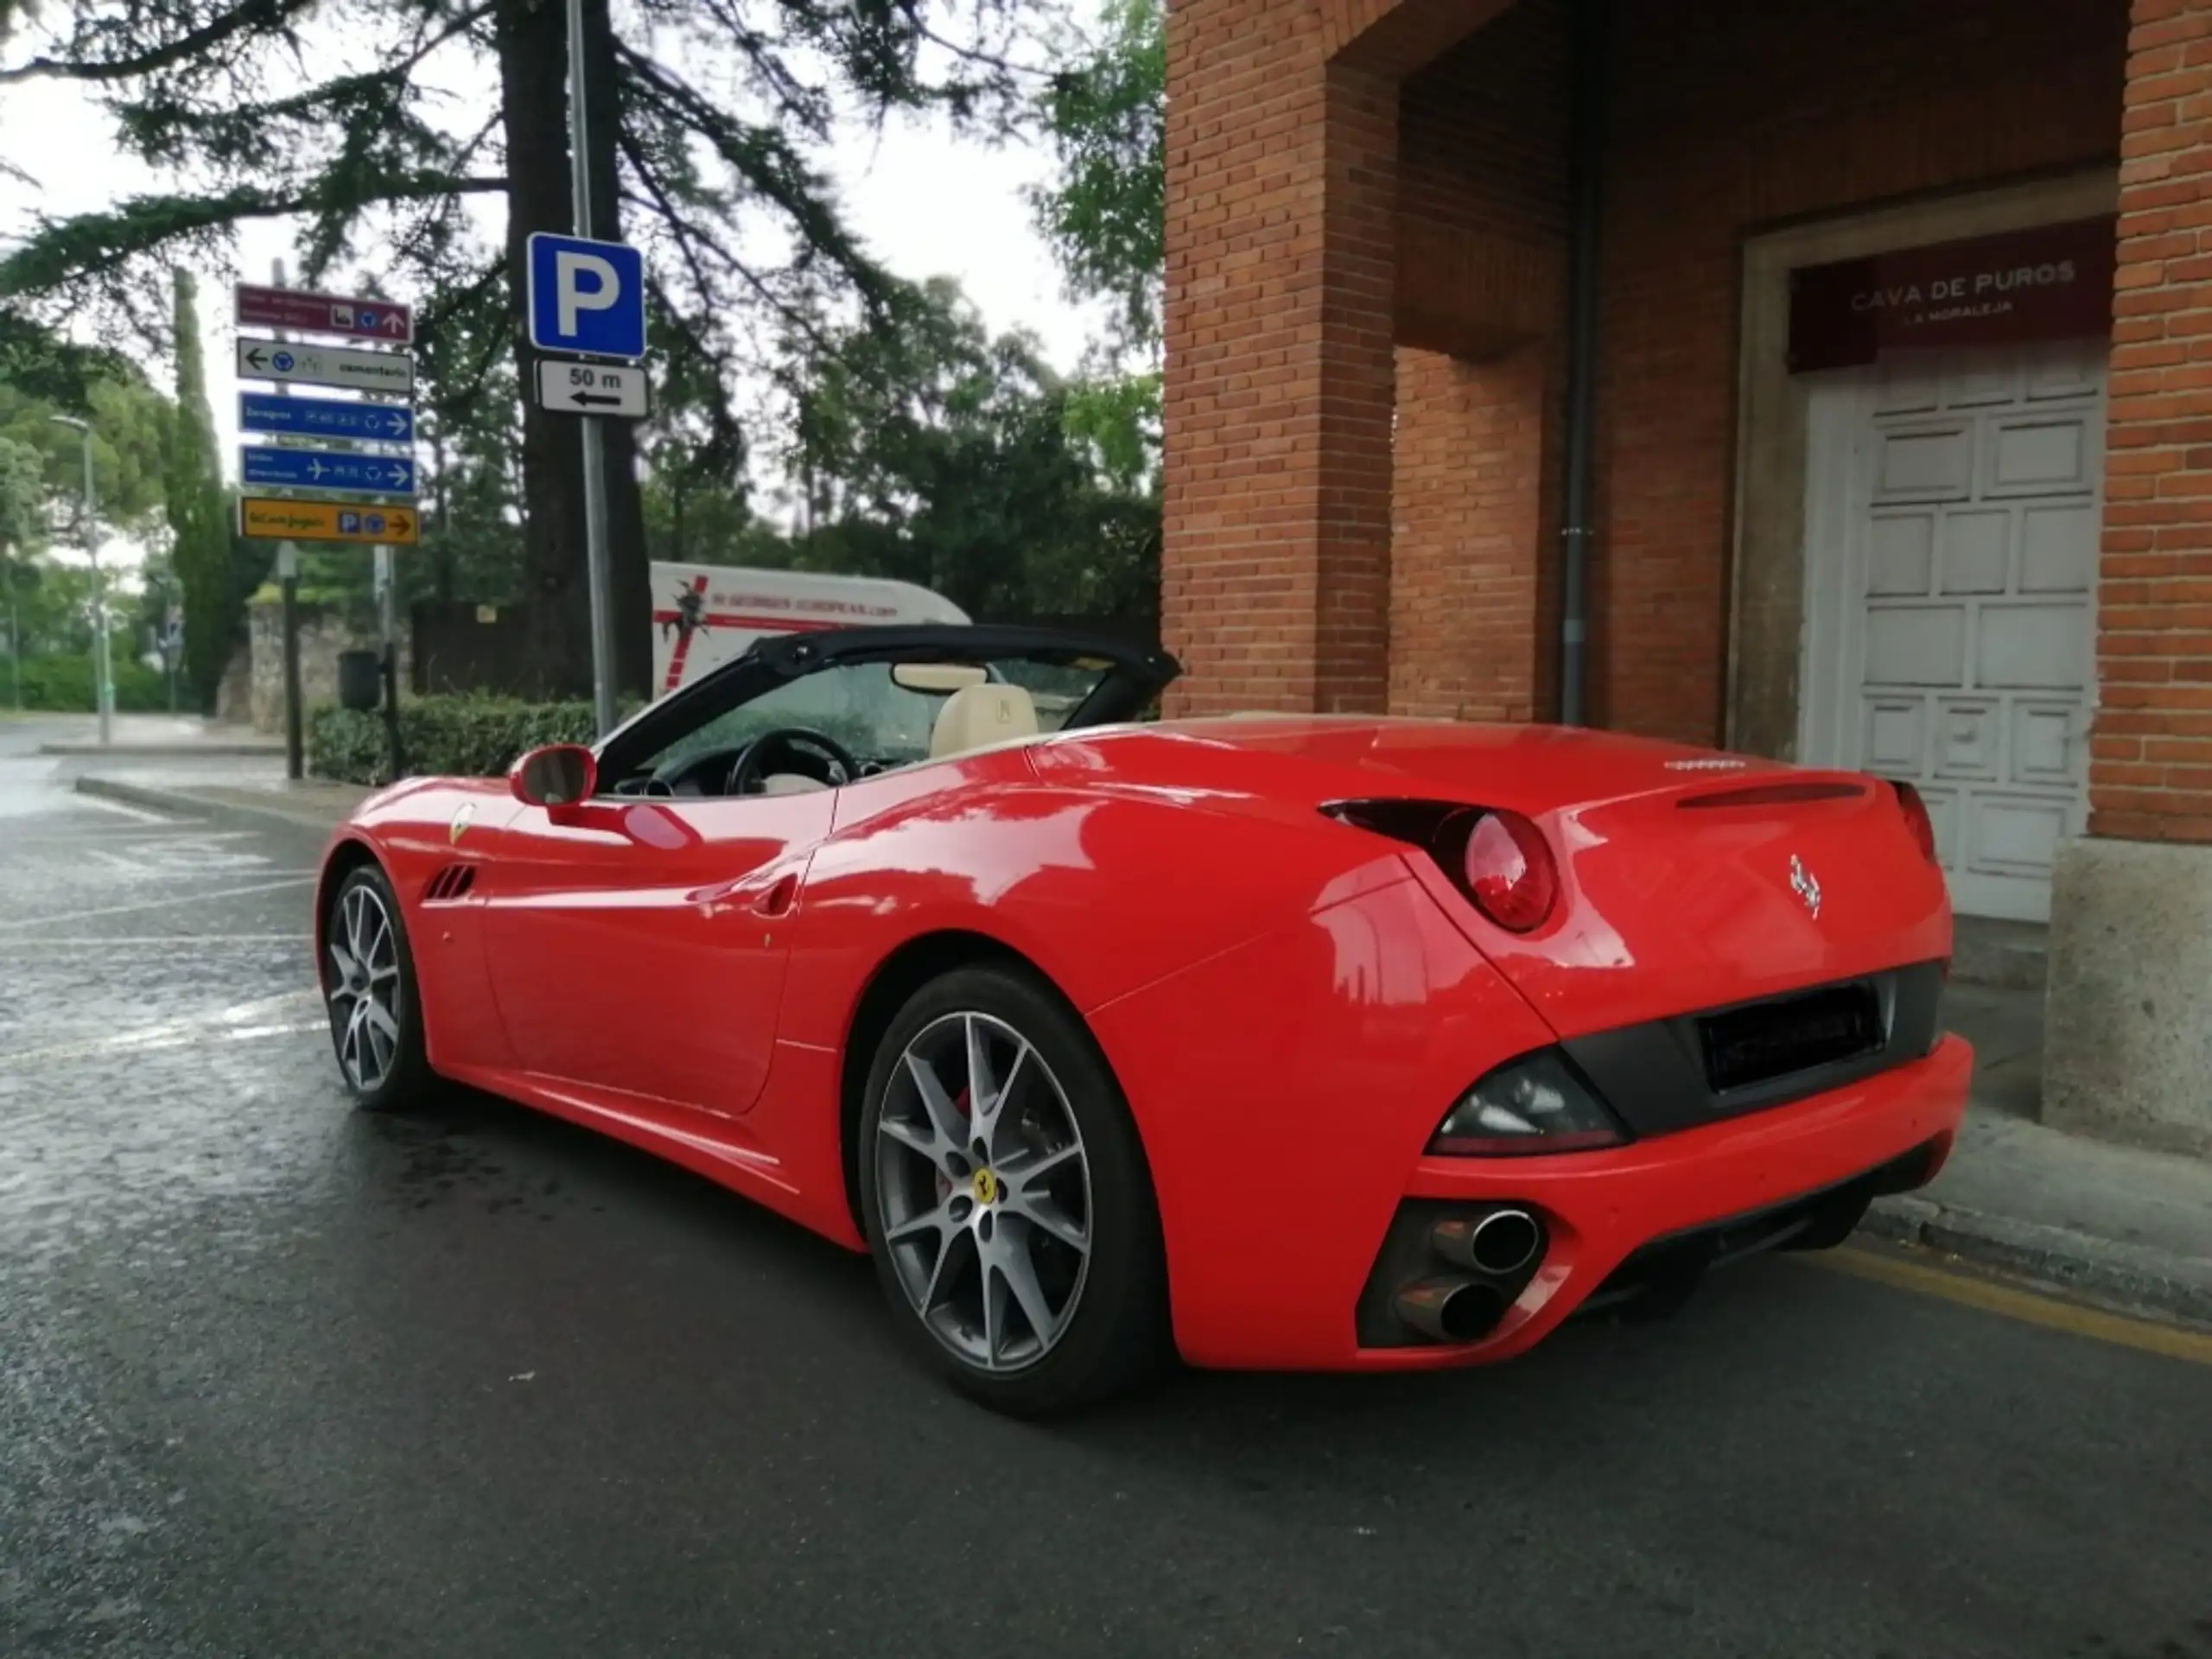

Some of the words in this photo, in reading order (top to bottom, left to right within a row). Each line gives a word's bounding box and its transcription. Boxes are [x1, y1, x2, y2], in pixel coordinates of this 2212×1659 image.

[556, 251, 620, 336] P
[1851, 284, 1923, 311] CAVA
[1931, 276, 1967, 300] DE
[1975, 259, 2075, 294] PUROS
[1904, 312, 1924, 326] LA
[1929, 300, 2013, 321] MORALEJA
[570, 368, 594, 386] 50
[602, 376, 621, 389] m
